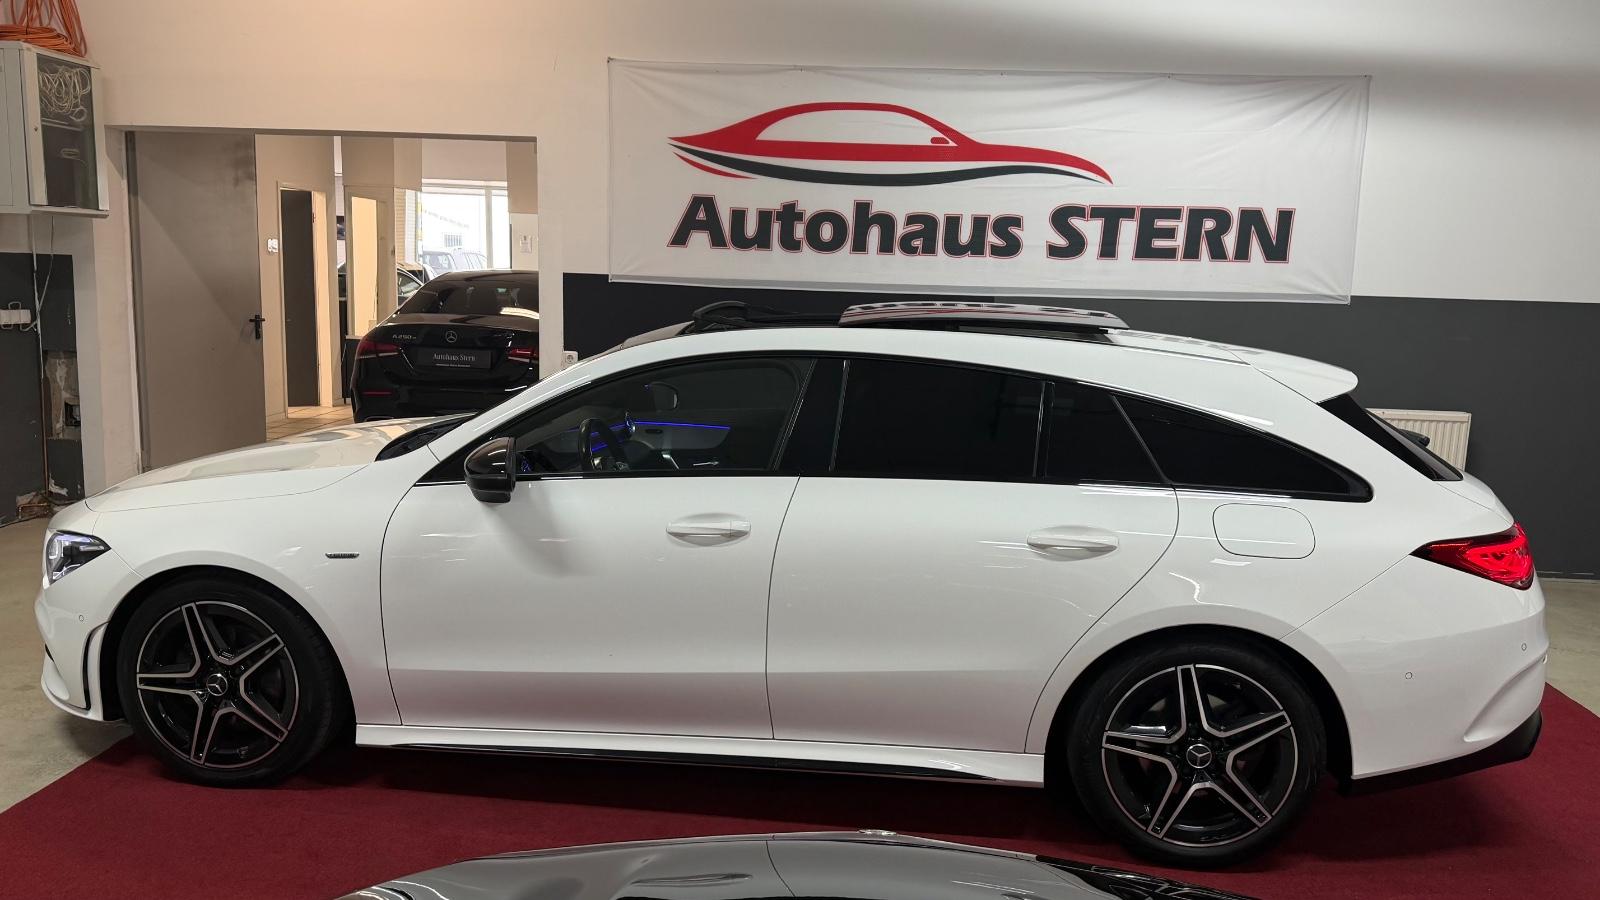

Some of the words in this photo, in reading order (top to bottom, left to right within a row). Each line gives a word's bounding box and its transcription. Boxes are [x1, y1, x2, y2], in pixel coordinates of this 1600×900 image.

[667, 194, 1023, 257] Autohaus
[1047, 204, 1296, 264] STERN
[432, 352, 459, 361] Autohaus
